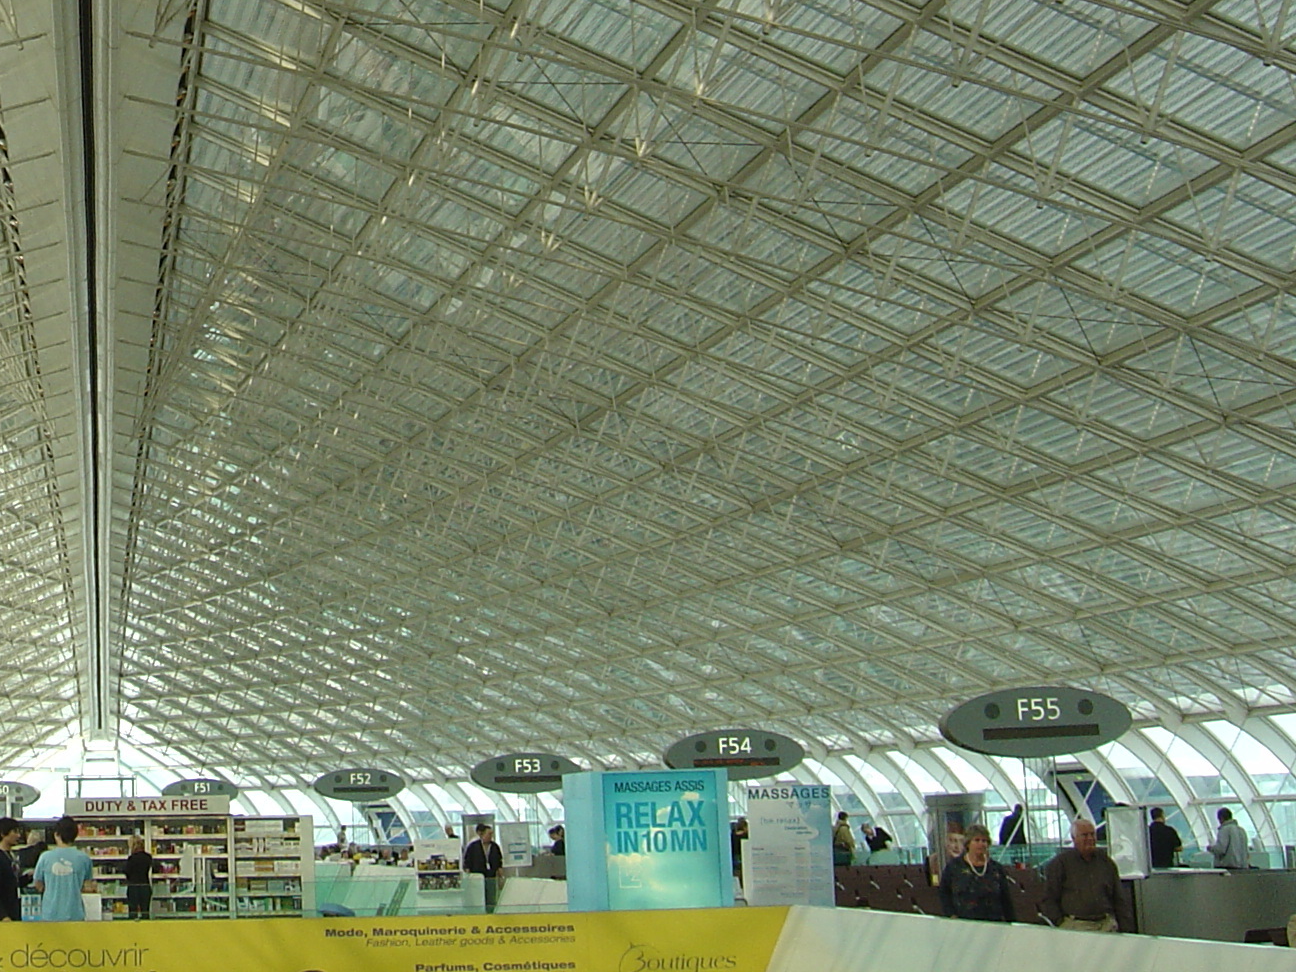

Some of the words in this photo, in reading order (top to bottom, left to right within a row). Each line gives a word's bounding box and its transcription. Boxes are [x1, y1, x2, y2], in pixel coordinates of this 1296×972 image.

[1016, 697, 1061, 721] F55
[718, 736, 753, 755] F54
[514, 758, 541, 773] F53
[349, 773, 371, 785] F52
[614, 780, 671, 793] MASSAGES
[675, 780, 705, 791] ASSIS
[194, 782, 211, 793] F51
[748, 787, 830, 800] MASSAGES
[85, 800, 122, 812] DUTY
[126, 800, 136, 812] &
[141, 800, 167, 812] TAX
[171, 799, 209, 811] FREE
[615, 800, 706, 829] RELAX
[616, 830, 640, 853] IN
[642, 830, 668, 853] 10
[670, 829, 707, 852] MN
[325, 928, 368, 938] Mode,
[372, 926, 466, 938] Maroquinerie
[470, 926, 480, 935] &
[486, 923, 575, 934] Accessoires
[365, 938, 412, 948] Fashion,
[415, 937, 456, 947] Leather
[460, 936, 495, 948] goods
[498, 935, 506, 945] &
[10, 942, 149, 968] découvrir
[618, 941, 737, 972] Boutiques
[415, 963, 479, 972] Parfums,
[483, 961, 576, 971] Cosmétiques
